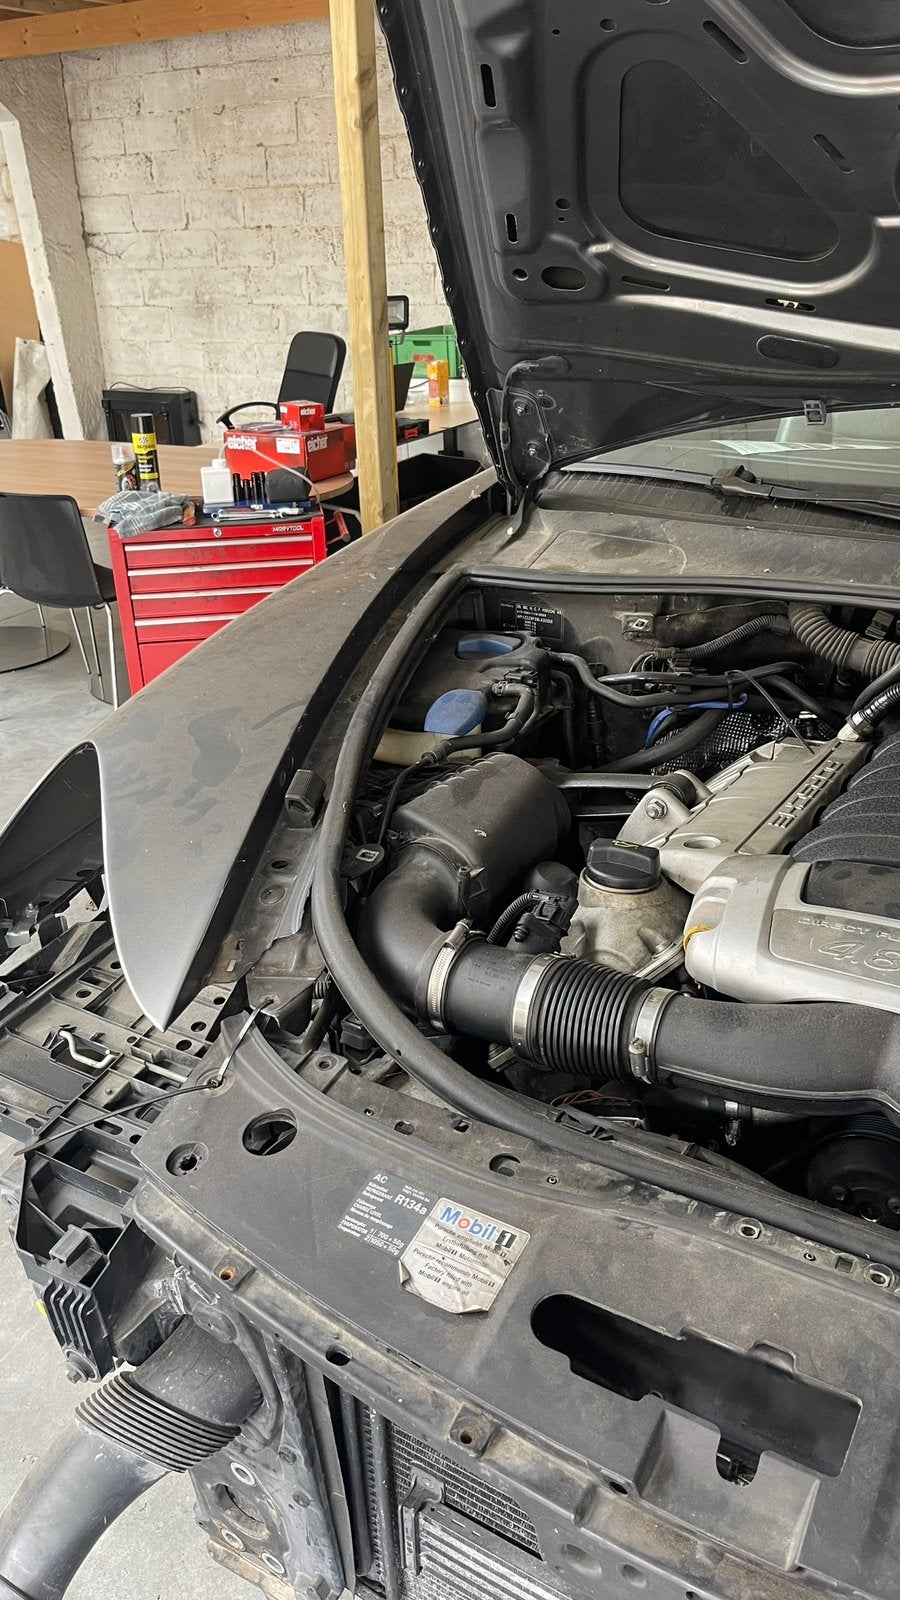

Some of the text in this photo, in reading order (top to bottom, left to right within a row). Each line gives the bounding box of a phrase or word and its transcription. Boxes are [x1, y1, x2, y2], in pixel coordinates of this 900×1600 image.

[300, 407, 316, 416] eicher
[227, 435, 257, 451] eicher
[307, 436, 328, 453] eicher
[798, 917, 871, 935] DIRECT
[373, 1173, 388, 1184] AC
[393, 1193, 428, 1215] R134a
[369, 1209, 382, 1218] LEVEL
[435, 1222, 456, 1236] Porsche
[439, 1205, 497, 1241] Mobil
[370, 1237, 385, 1248] 1050
[387, 1245, 400, 1256] 50g
[378, 1230, 390, 1241] 700
[392, 1237, 405, 1249] 50g
[435, 1242, 452, 1255] Mobil
[413, 1247, 436, 1261] Porsche
[435, 1257, 471, 1278] recommends
[471, 1273, 489, 1285] Mobil
[418, 1269, 436, 1282] Mobil
[424, 1262, 473, 1288] Factory filled with
